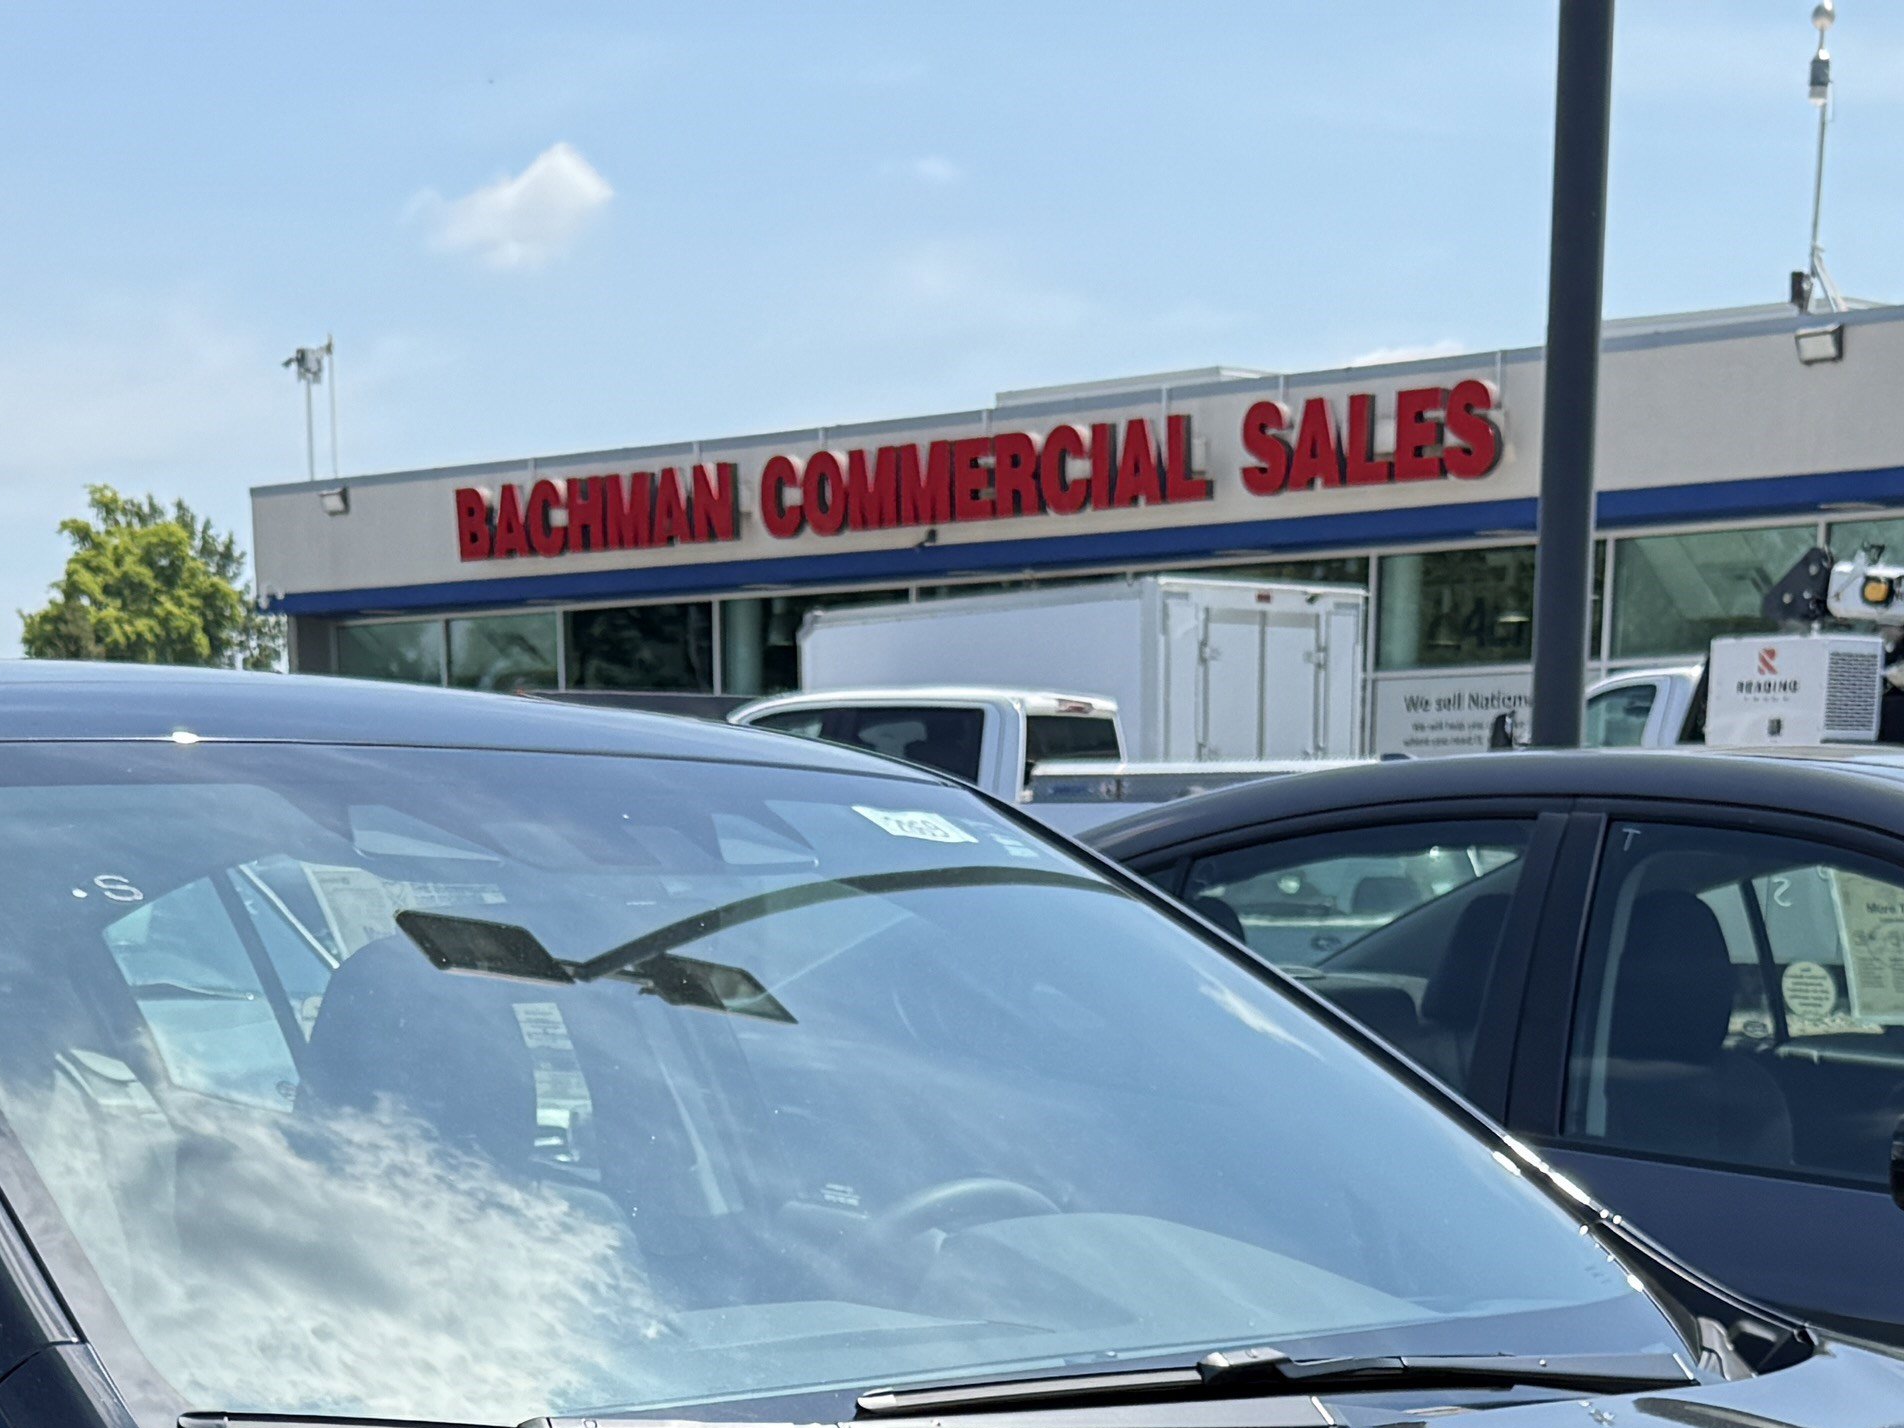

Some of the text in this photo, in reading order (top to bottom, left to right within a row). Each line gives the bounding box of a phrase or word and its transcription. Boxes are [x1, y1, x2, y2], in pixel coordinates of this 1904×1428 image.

[455, 378, 1503, 562] BACHMAN COMMERCIAL SALES
[1735, 679, 1800, 694] READING
